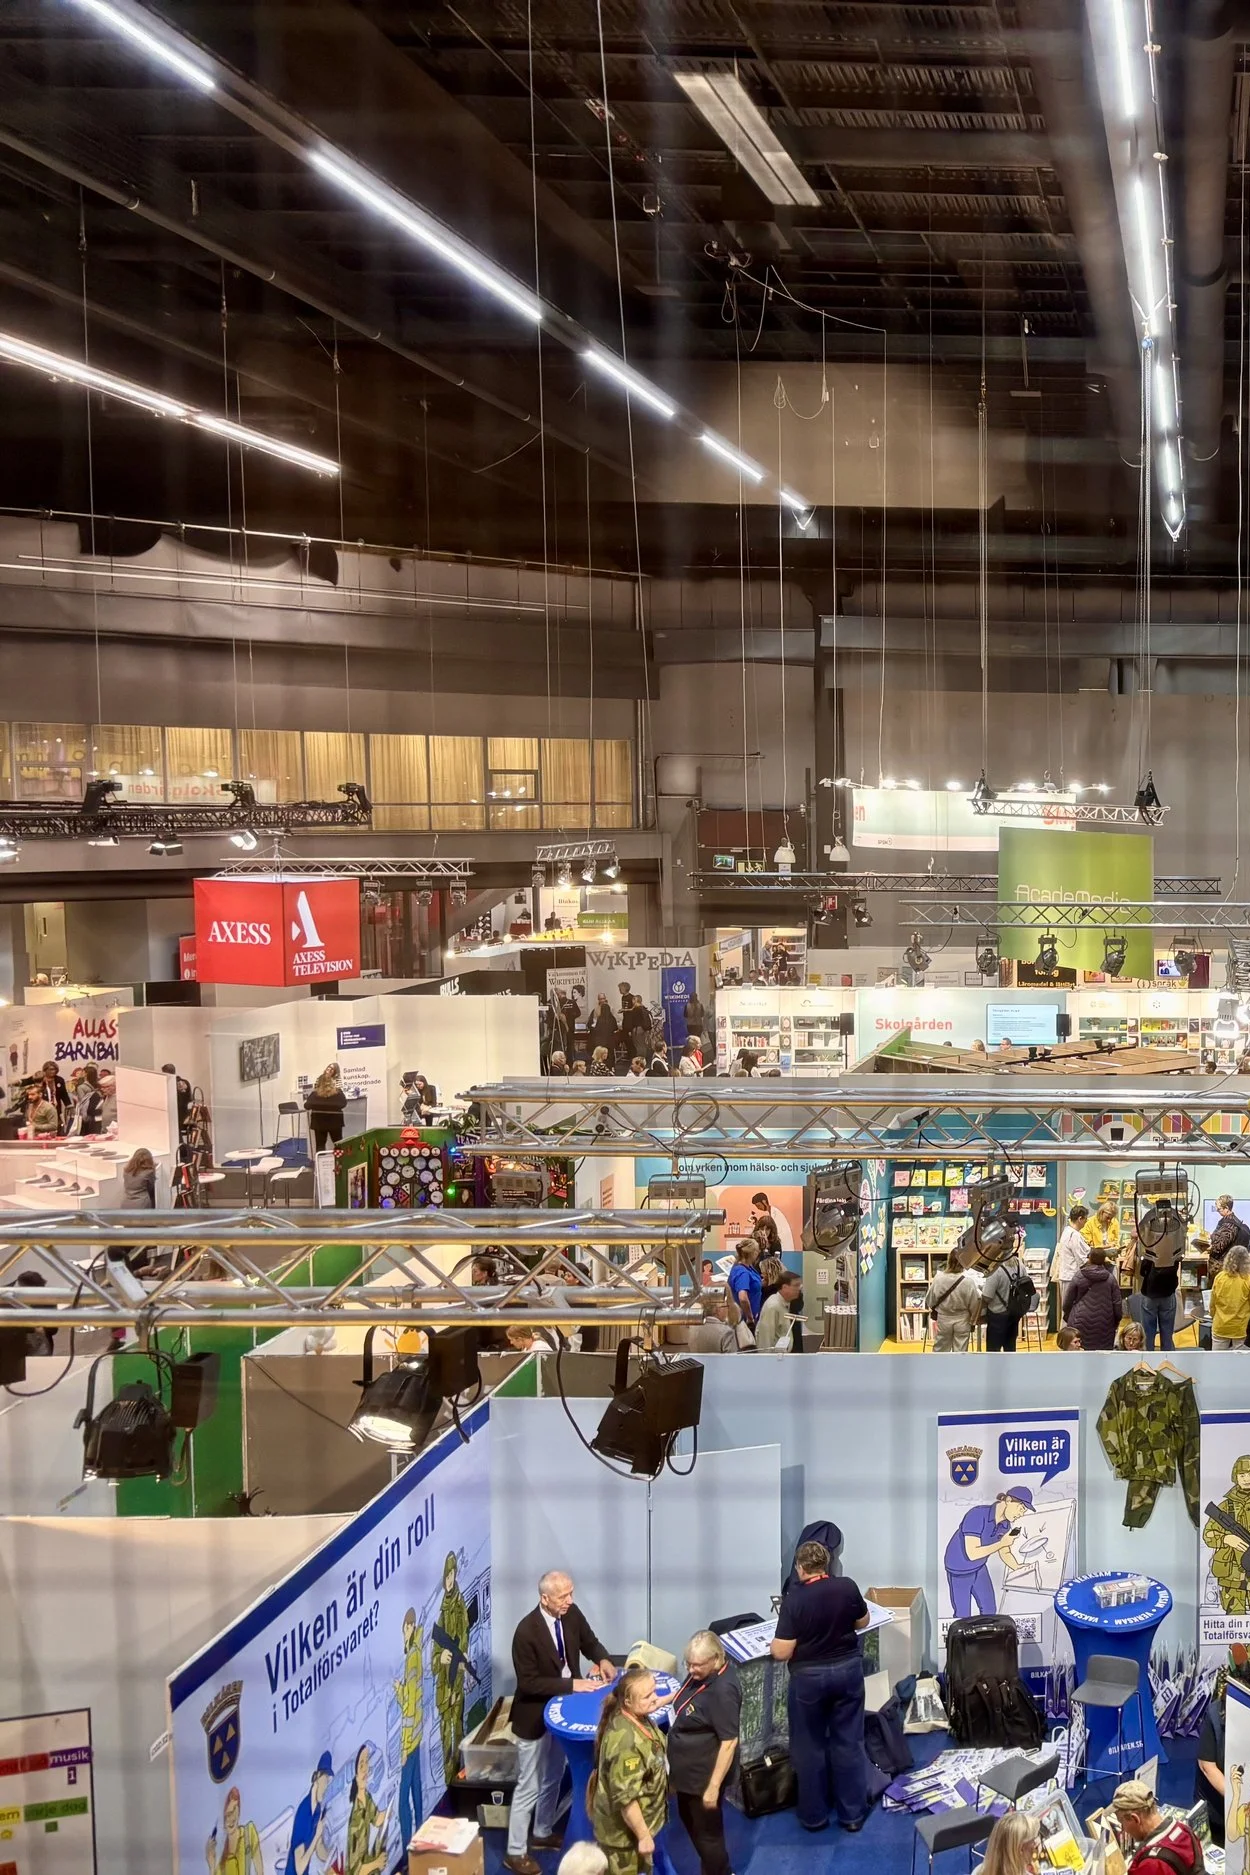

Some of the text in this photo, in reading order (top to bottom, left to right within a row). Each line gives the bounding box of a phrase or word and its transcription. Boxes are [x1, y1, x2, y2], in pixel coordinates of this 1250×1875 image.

[208, 921, 271, 945] AXESS
[293, 950, 326, 965] AXESS
[586, 951, 695, 970] WIKIPEDIA
[293, 959, 353, 976] TELEVISION
[548, 977, 586, 986] WIKIPEDIA
[73, 1017, 118, 1039] ALLAS
[875, 1018, 953, 1032] Skolgården
[679, 1163, 799, 1174] om yrken inom hälso- och
[1005, 1436, 1066, 1452] Vilken är
[1005, 1451, 1060, 1467] din roll?
[264, 1493, 435, 1695] Vilken är din roll
[1114, 1611, 1154, 1625] VERKSAM
[1203, 1619, 1225, 1629] Hitta
[1228, 1619, 1242, 1628] din
[281, 1600, 380, 1721] Totalförsvaret?
[50, 1750, 89, 1765] musik
